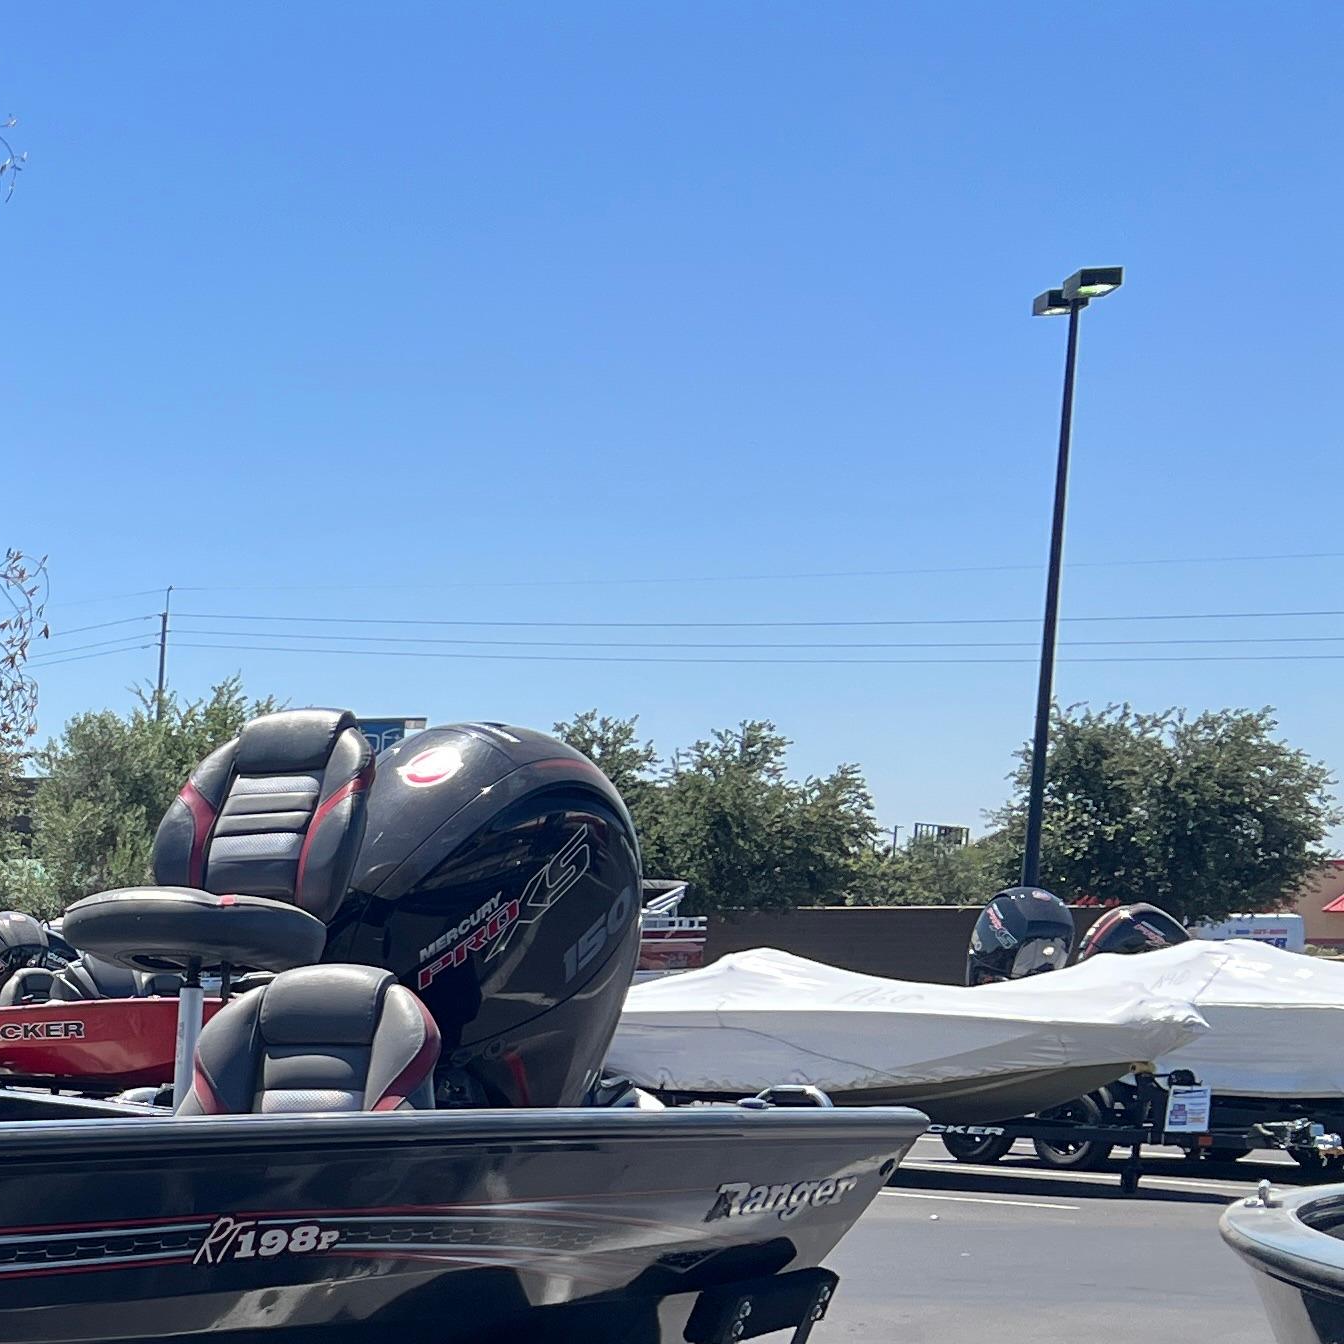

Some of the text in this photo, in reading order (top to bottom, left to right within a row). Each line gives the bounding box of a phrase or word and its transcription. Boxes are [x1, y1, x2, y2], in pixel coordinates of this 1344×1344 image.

[418, 899, 520, 990] PRO
[419, 891, 503, 963] MERCURY
[564, 887, 633, 984] 150
[703, 1177, 857, 1222] Ranger
